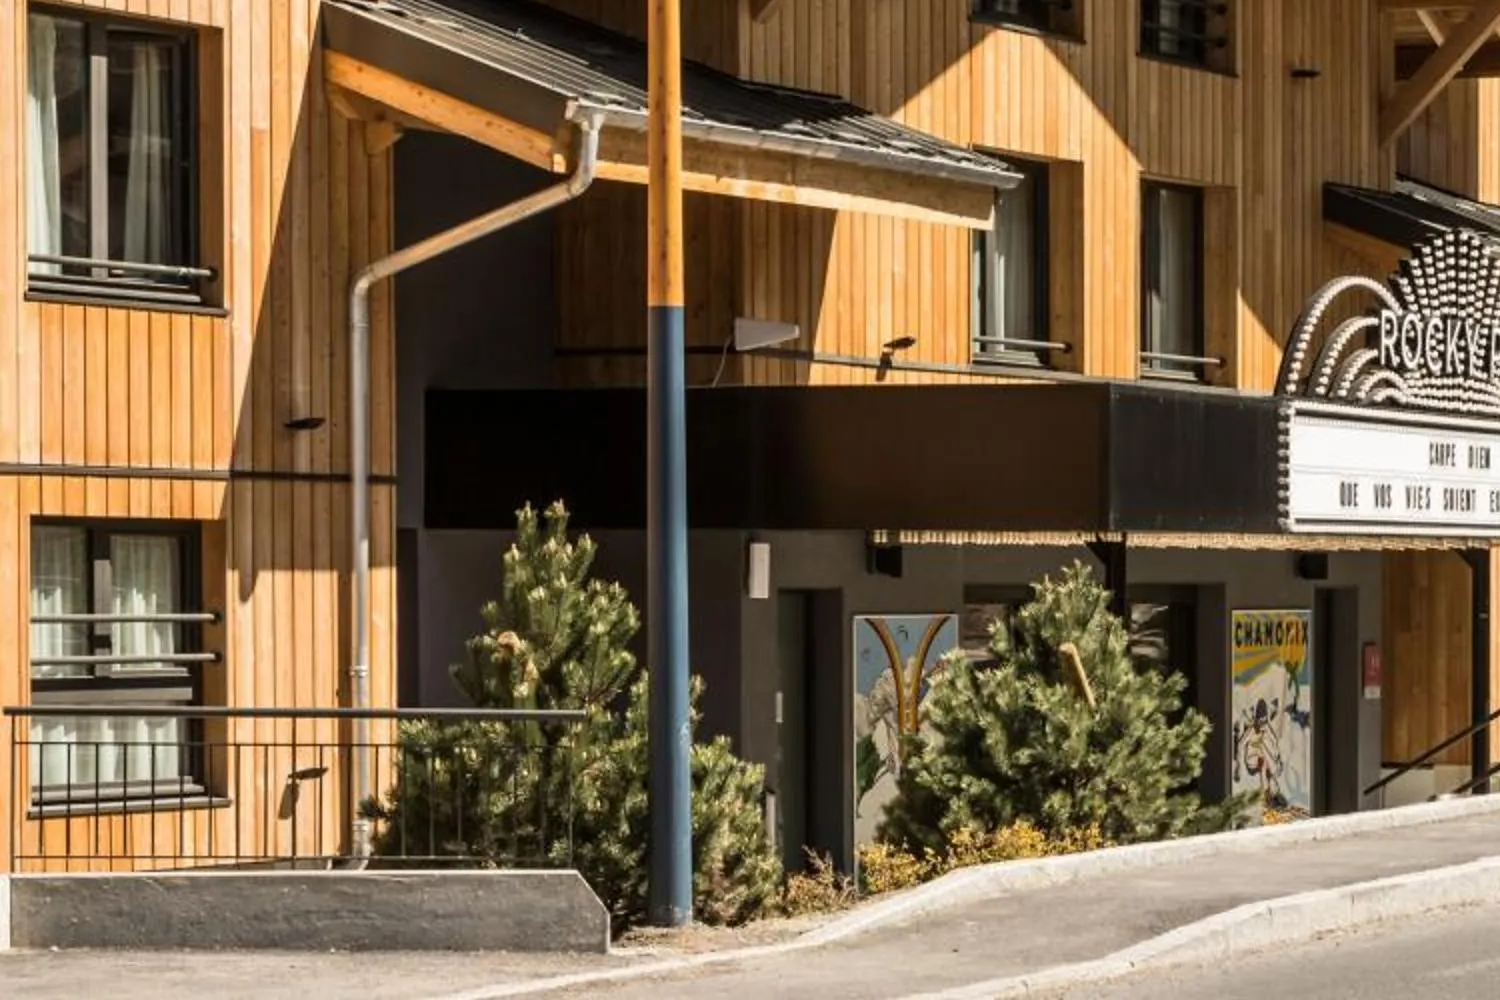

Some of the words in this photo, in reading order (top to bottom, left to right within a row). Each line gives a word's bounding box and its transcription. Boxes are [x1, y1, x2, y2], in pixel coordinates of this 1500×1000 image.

[1381, 309, 1481, 377] ROCKY
[1429, 442, 1456, 467] CARPE
[1468, 445, 1491, 469] DIEM
[1339, 481, 1358, 508] QUE
[1373, 484, 1392, 509] VOS
[1405, 486, 1431, 510] VIES
[1443, 488, 1476, 512] SOIENT
